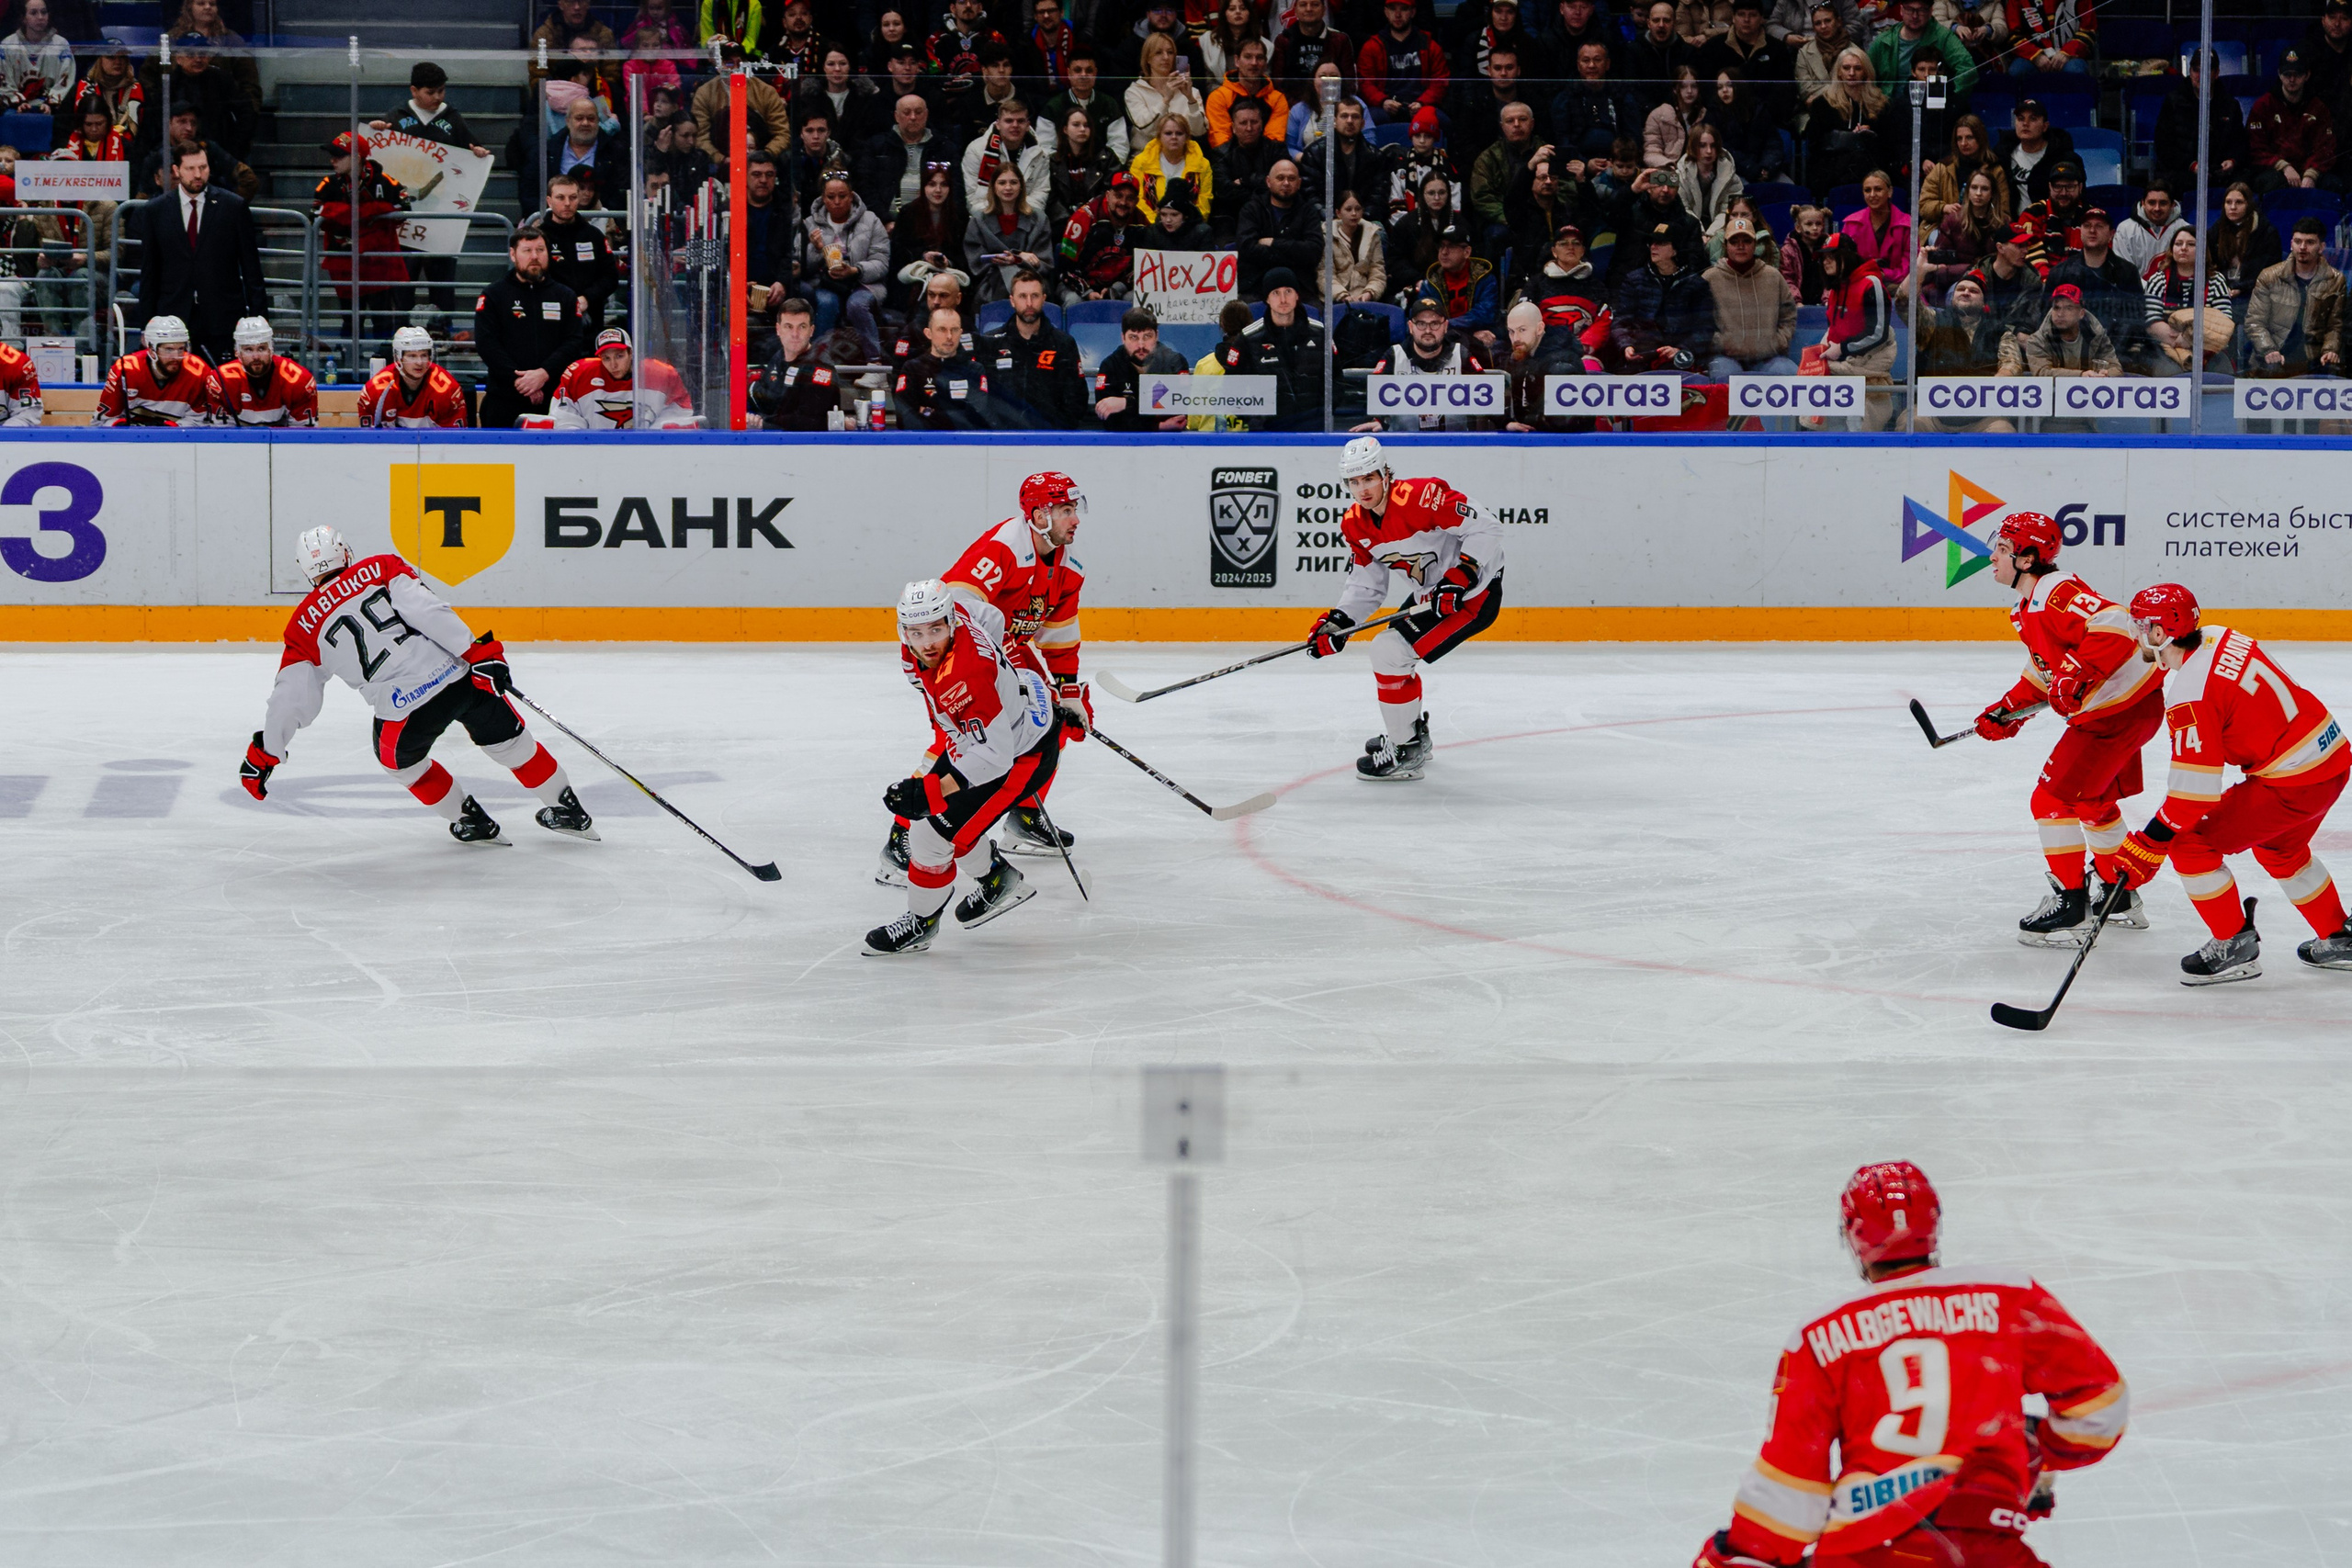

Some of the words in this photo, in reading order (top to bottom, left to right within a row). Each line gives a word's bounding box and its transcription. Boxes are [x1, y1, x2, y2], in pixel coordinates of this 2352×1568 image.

[34, 177, 122, 187] T.ME/KRSCHINA
[1066, 220, 1082, 240] 19
[1171, 393, 1264, 406] Ростелеком
[1215, 471, 1273, 483] FONBET
[1296, 483, 1354, 500] ФОН
[424, 496, 481, 547] Т
[545, 497, 795, 548] БАНК
[2165, 512, 2280, 529] система
[1295, 532, 1349, 547] ХОК
[2165, 534, 2300, 558] платежей
[314, 559, 329, 573] 29
[970, 557, 1003, 592] 92
[1215, 572, 1272, 583] 2024/2025
[297, 561, 382, 635] KABLUKOV
[2067, 592, 2102, 619] 13
[324, 586, 406, 682] 29
[2175, 726, 2203, 756] 74
[1144, 763, 1188, 796] TRUE
[935, 812, 953, 829] ERGY
[1806, 1292, 2001, 1368] HALBGEWACHS
[1871, 1337, 1951, 1459] 9
[1988, 1507, 2030, 1532] CC
